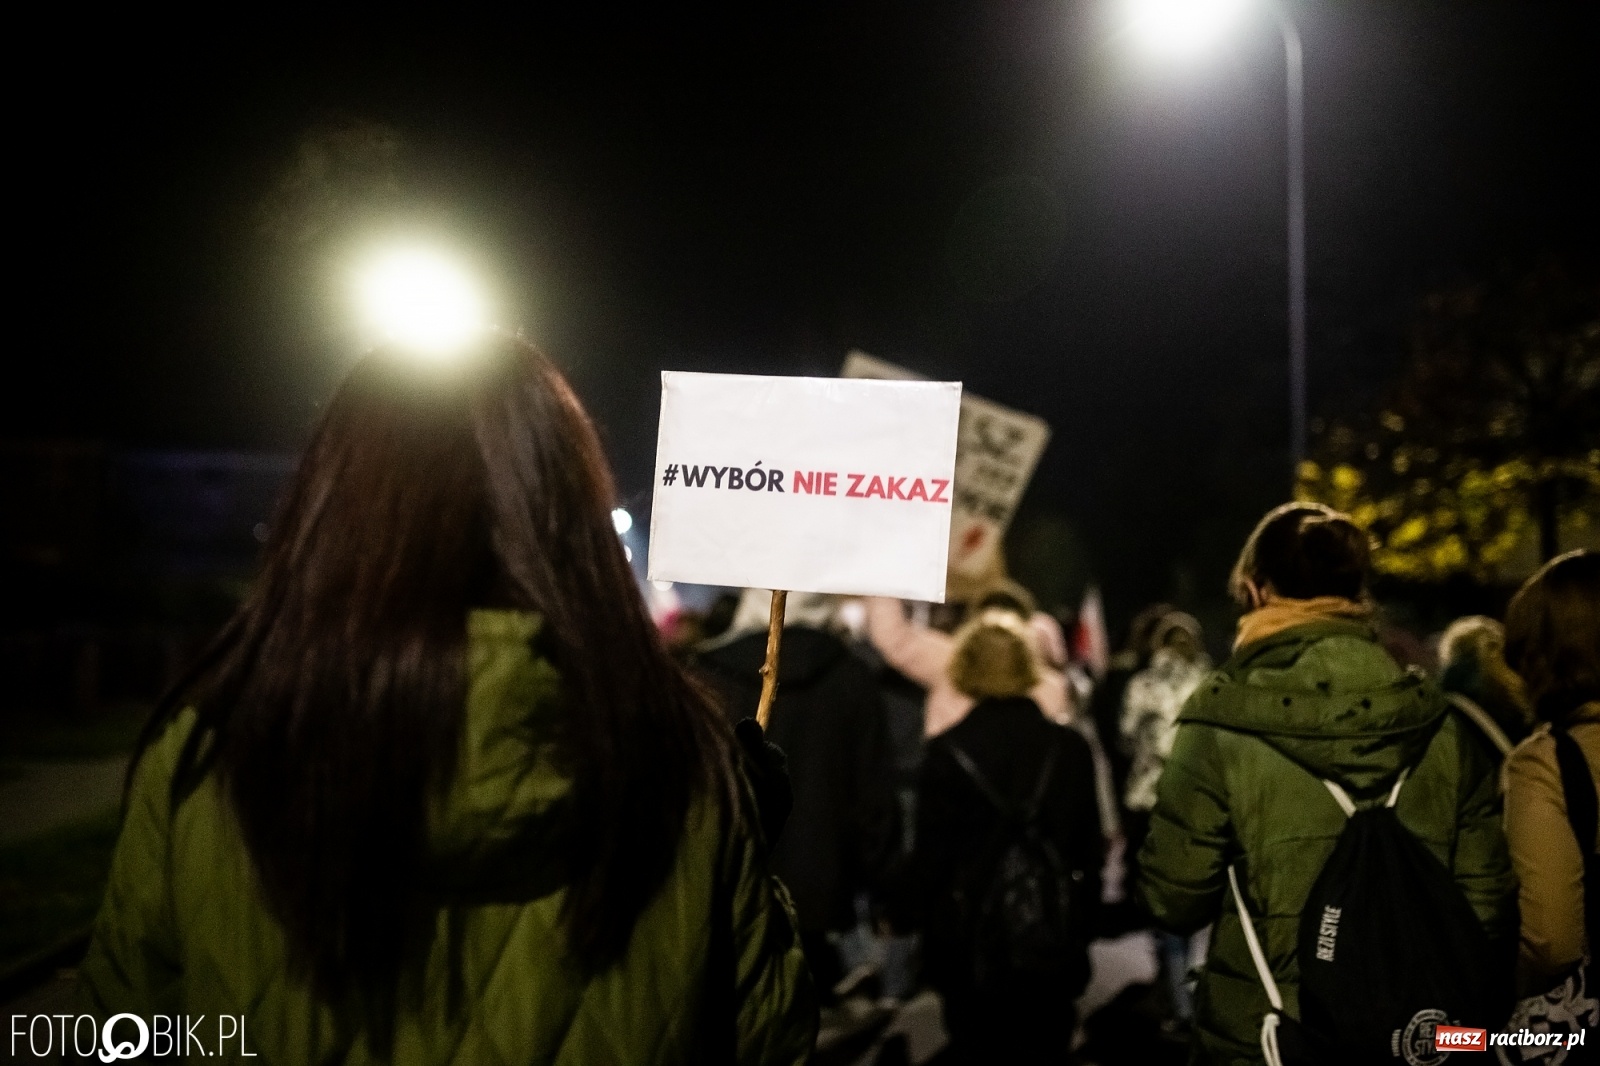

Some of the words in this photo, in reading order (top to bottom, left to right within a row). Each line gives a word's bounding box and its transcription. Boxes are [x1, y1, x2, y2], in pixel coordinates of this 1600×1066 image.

[662, 460, 785, 493] #WYBÓR
[793, 470, 838, 496] NIE
[845, 473, 950, 503] ZAKAZ
